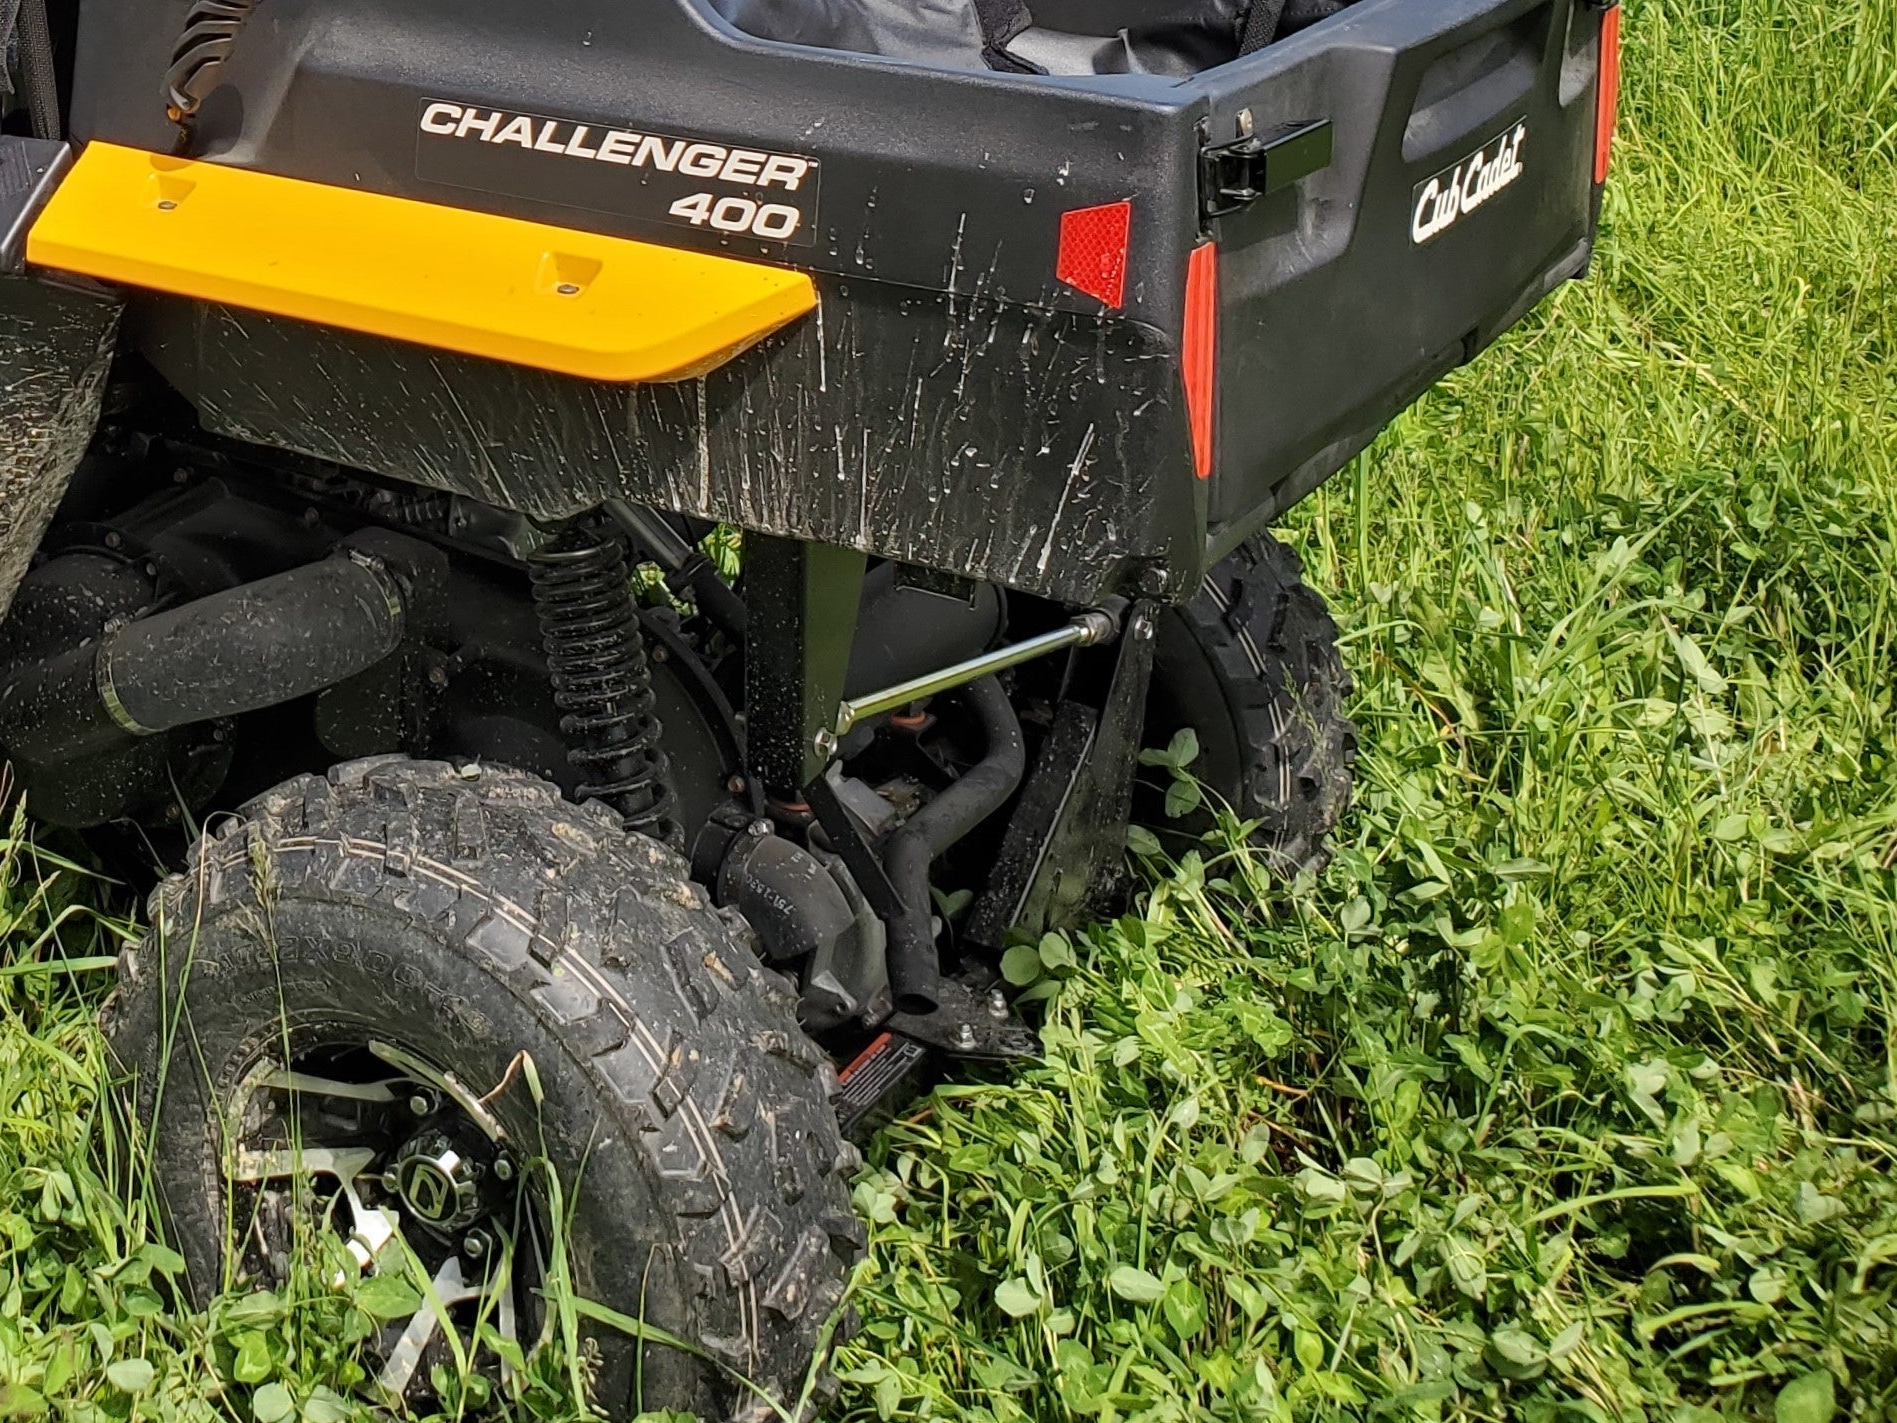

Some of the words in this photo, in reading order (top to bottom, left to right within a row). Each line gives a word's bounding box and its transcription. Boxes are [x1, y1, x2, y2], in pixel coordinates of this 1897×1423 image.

[668, 192, 801, 240] 400
[1412, 164, 1461, 244] Cub
[1461, 123, 1525, 214] Cadet
